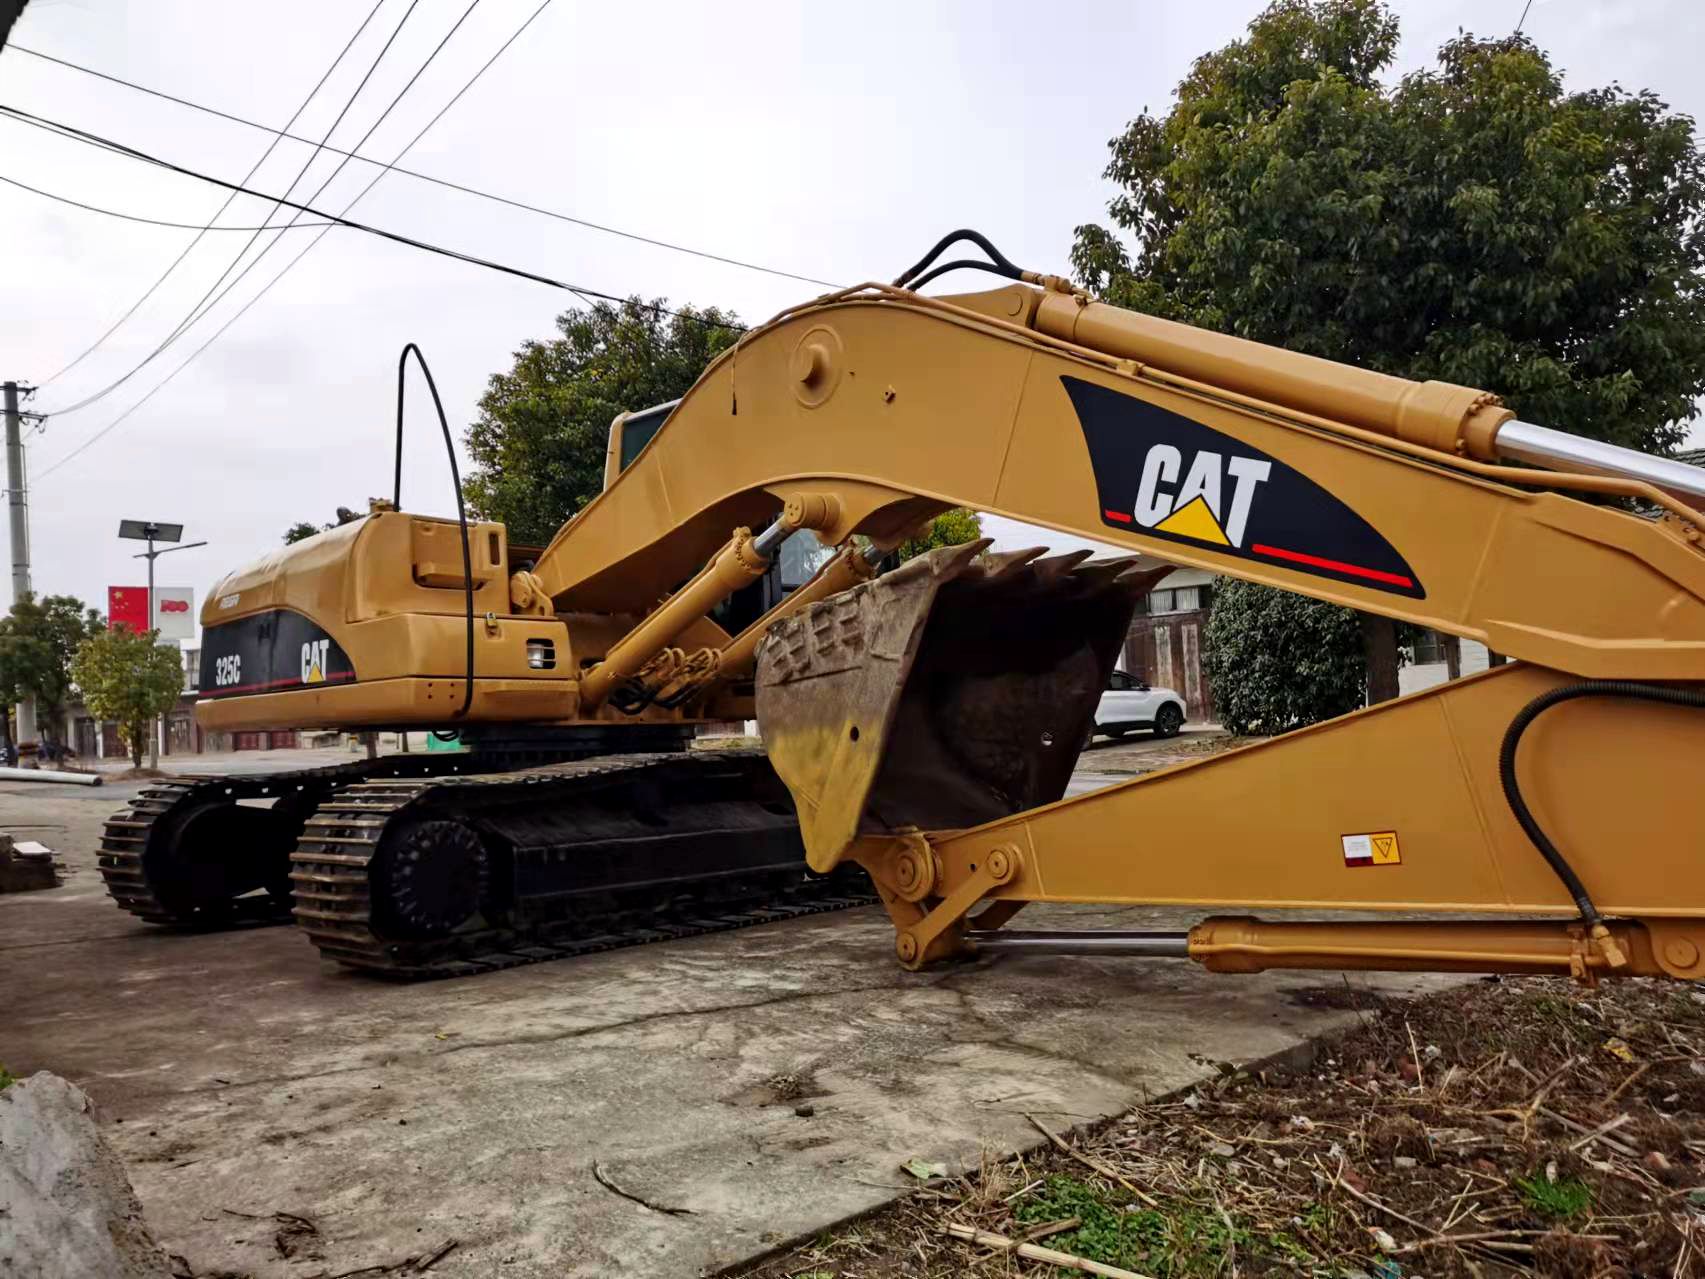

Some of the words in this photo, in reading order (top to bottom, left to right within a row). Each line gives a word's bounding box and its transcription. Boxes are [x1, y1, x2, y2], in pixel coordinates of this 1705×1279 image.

[1134, 443, 1272, 548] CAT
[216, 654, 241, 686] 325C
[301, 639, 329, 684] CAT
